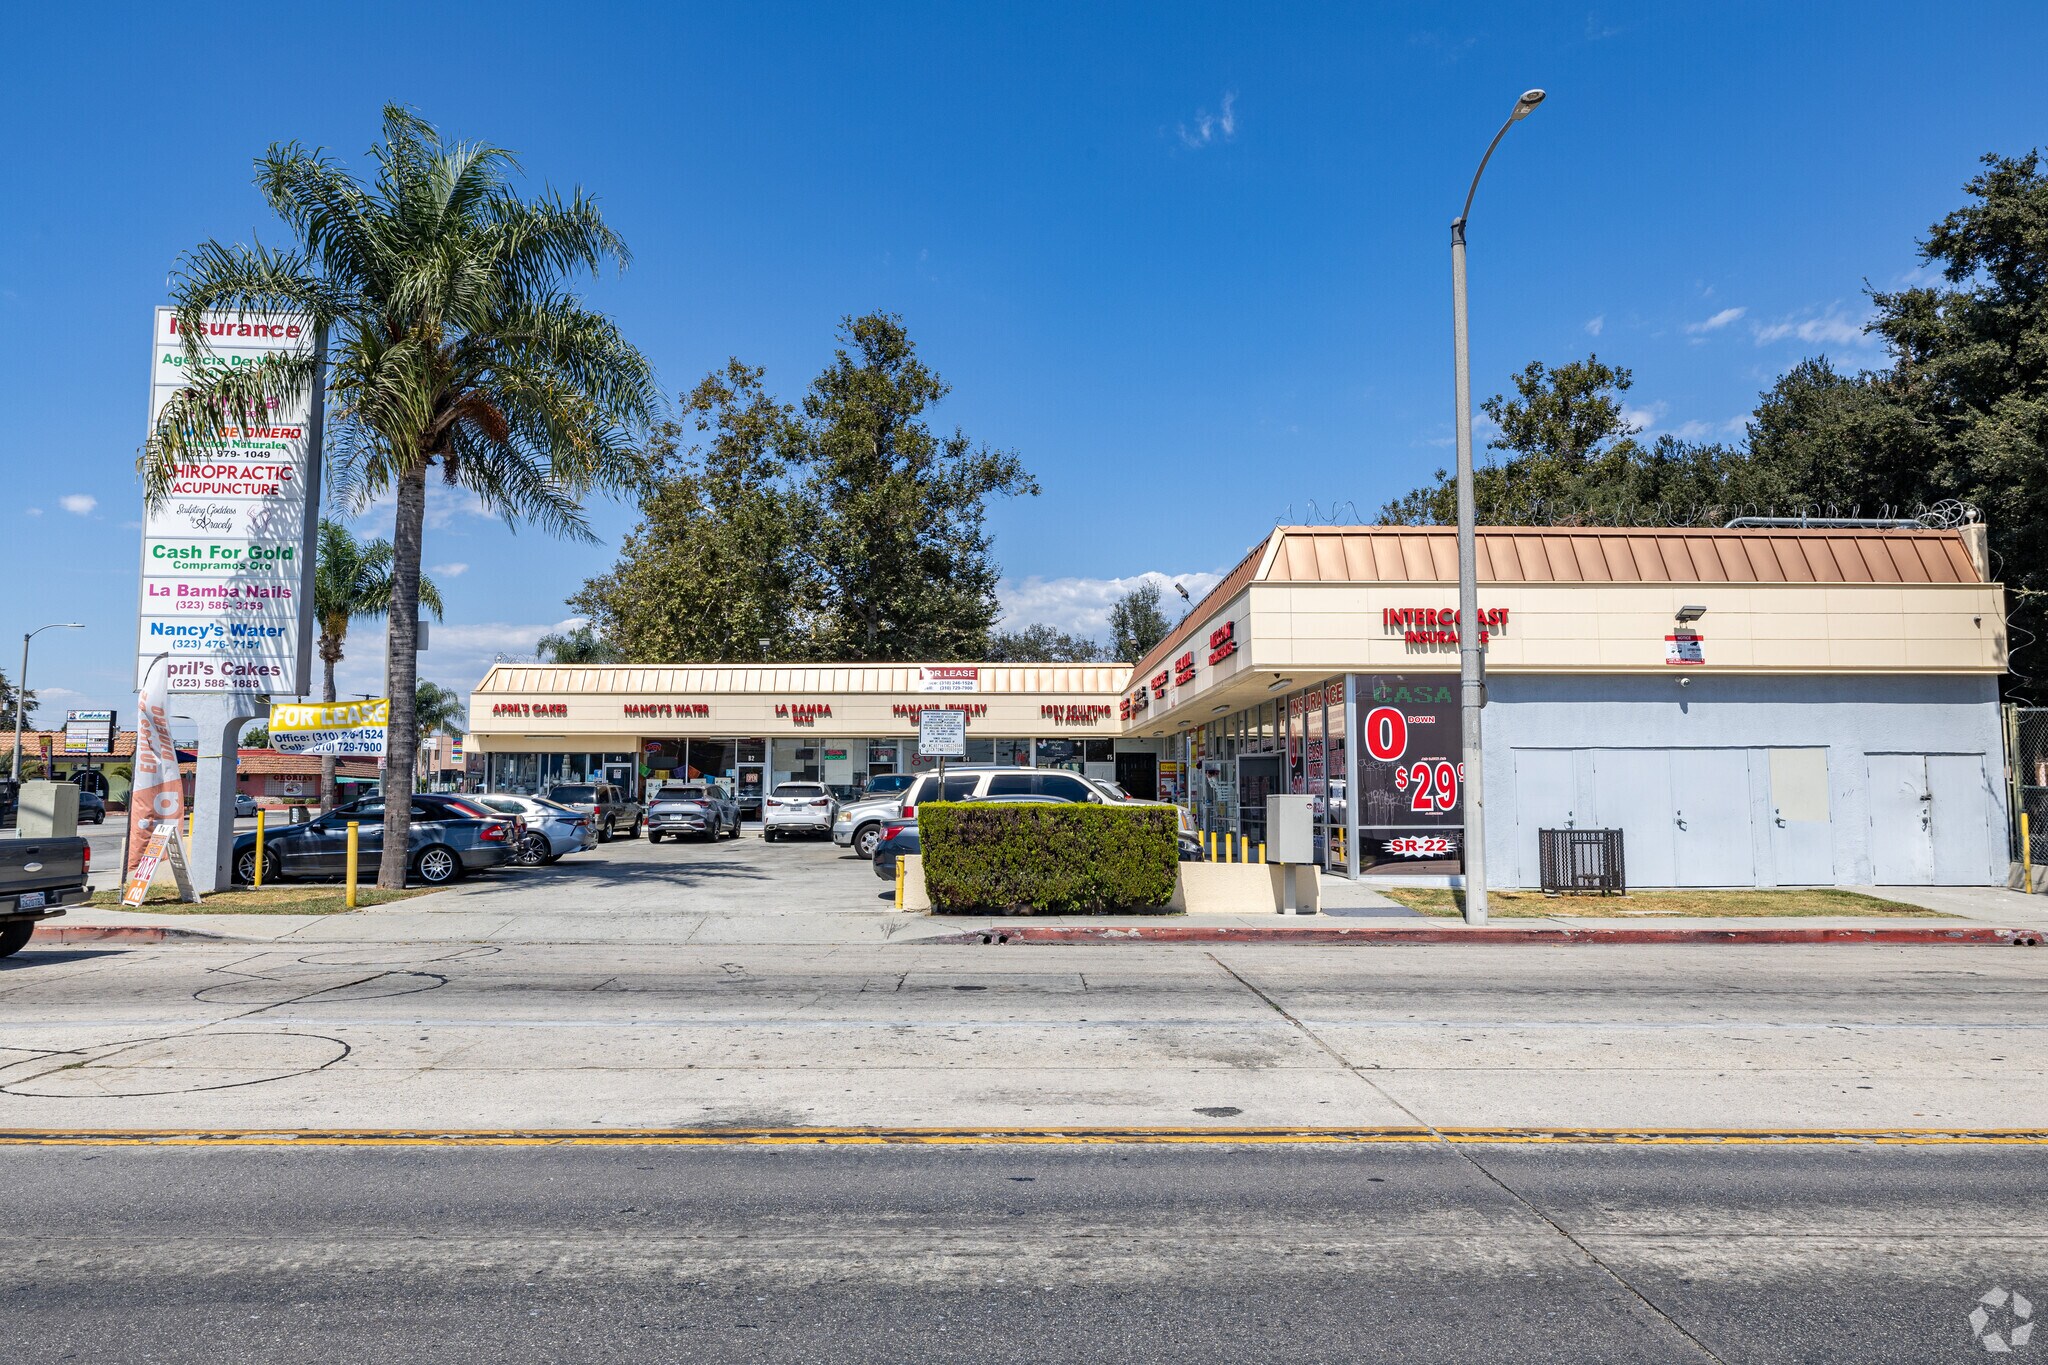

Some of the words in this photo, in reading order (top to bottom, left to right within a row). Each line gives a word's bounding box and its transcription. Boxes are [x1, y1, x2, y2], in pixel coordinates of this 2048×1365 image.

[162, 353, 226, 367] Agcia
[231, 439, 287, 451] Naturales
[217, 450, 241, 459] 979-
[245, 451, 271, 459] 1049
[172, 482, 279, 496] ACUPUNCTURE
[206, 503, 237, 518] Goddess
[152, 544, 202, 559] Cash
[209, 545, 241, 559] For
[248, 546, 294, 560] Gold
[172, 560, 246, 572] Compramos
[249, 561, 272, 571] Oro
[148, 583, 171, 597] La
[177, 584, 240, 598] Bamba
[246, 585, 292, 599] Nails
[175, 601, 204, 611] (323)
[208, 601, 232, 610] 585-
[235, 602, 264, 610] 3159
[150, 622, 224, 640] Nancy's
[230, 623, 286, 638] Water
[1404, 630, 1490, 643] INSURAE
[172, 639, 202, 650] (323)
[205, 640, 230, 649] 476-
[233, 640, 260, 649] 7151
[167, 661, 214, 678] pril's
[220, 661, 281, 676] Cakes
[944, 669, 975, 677] LEASE
[172, 678, 201, 689] (323)
[204, 679, 229, 688] 588-
[232, 679, 259, 688] 1888
[1289, 682, 1345, 717] INSURANCE
[1373, 686, 1452, 703] CASA
[492, 703, 530, 714] APRIL'S
[531, 703, 568, 714] CAKES
[623, 704, 672, 714] NANCY'S
[674, 704, 710, 714] WATER
[775, 704, 788, 714] LA
[792, 704, 832, 714] BAMBA
[1041, 705, 1065, 715] BODY
[1066, 705, 1111, 715] SCULPTING
[272, 707, 315, 727] FOR
[321, 703, 387, 725] LEASE
[274, 732, 310, 743] Office:
[312, 732, 339, 743] (310)
[1365, 706, 1408, 762] 0
[1407, 716, 1436, 724] DOWN
[337, 742, 382, 752] 729-7900
[1391, 839, 1448, 852] SR-22
